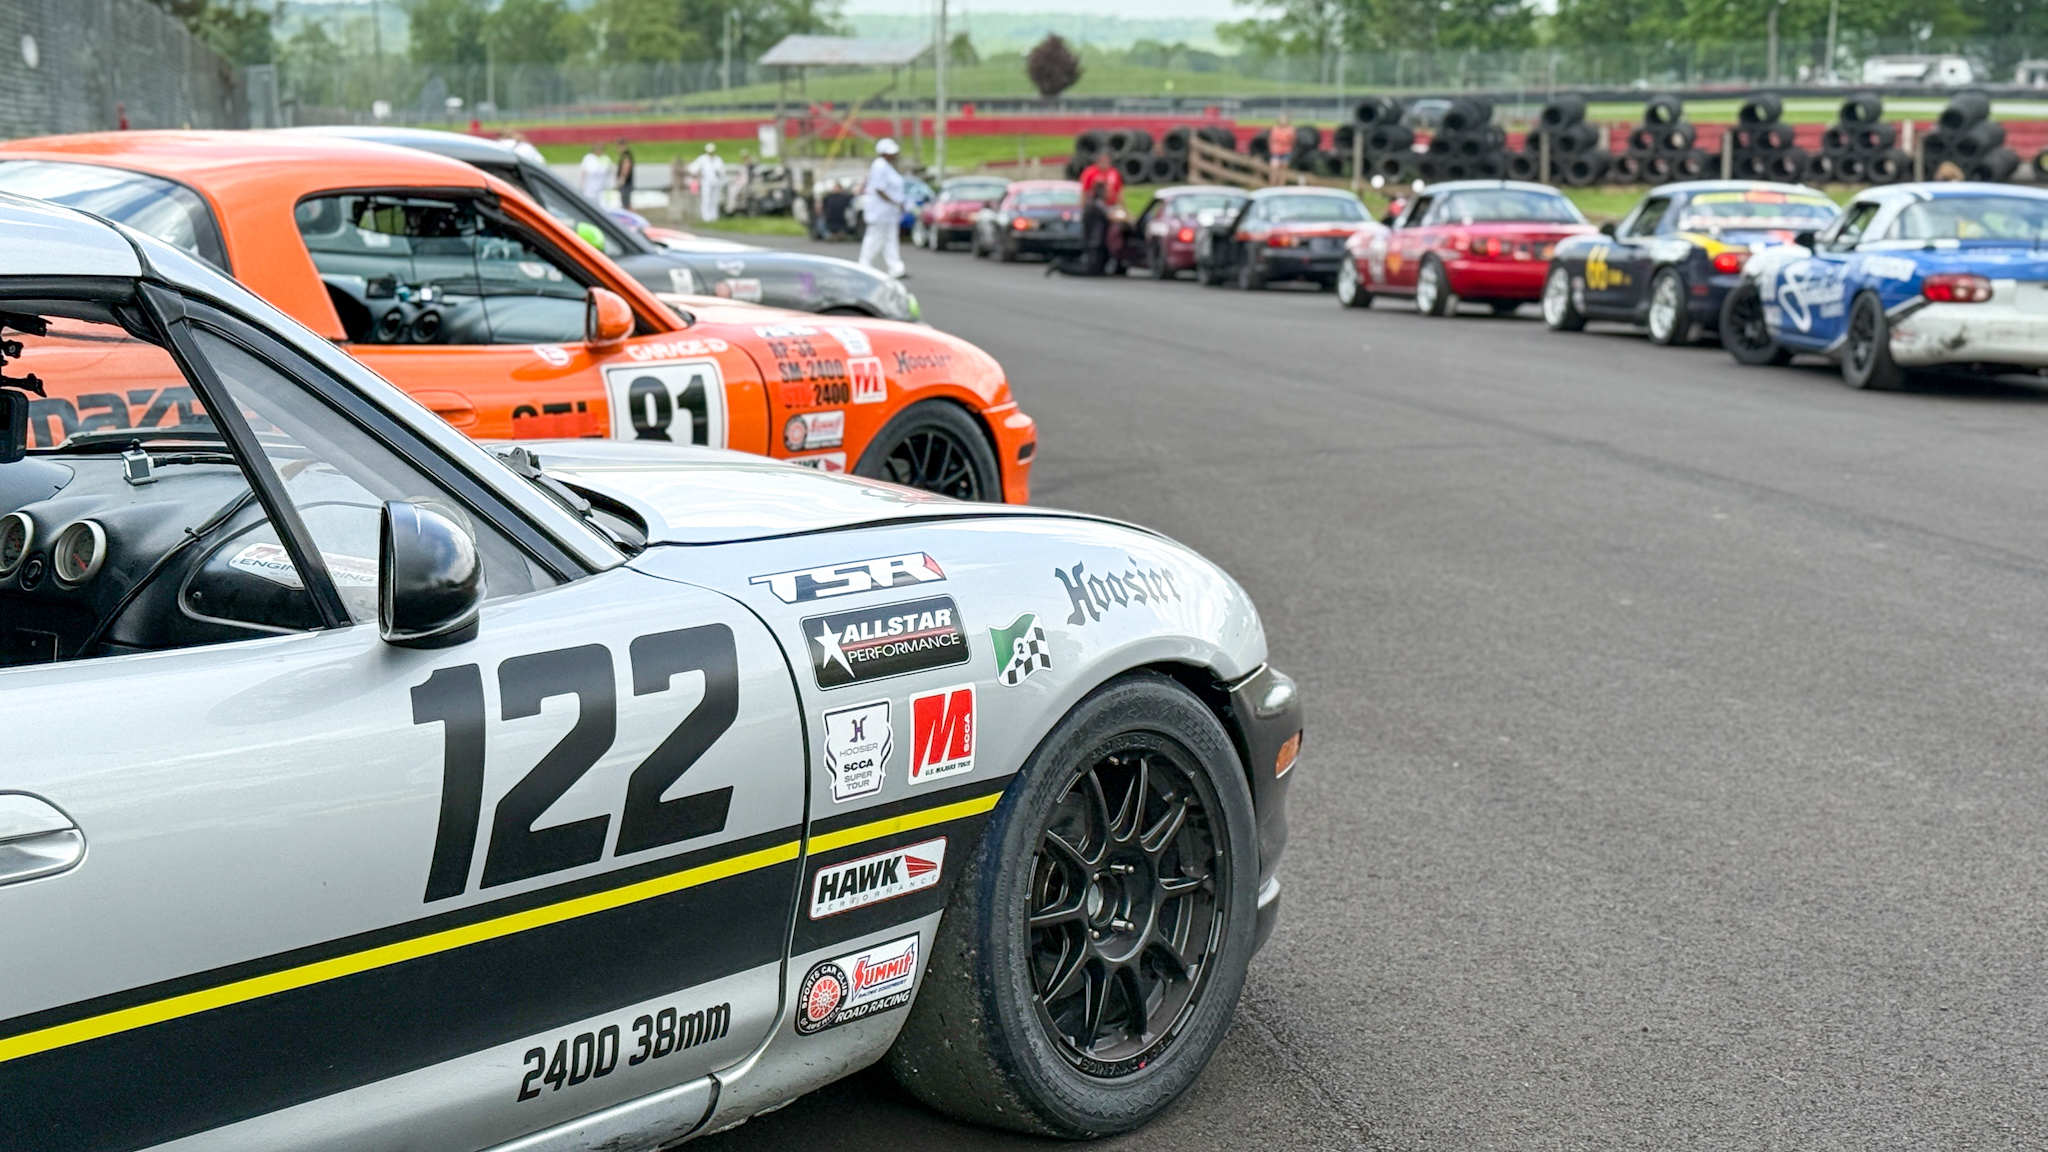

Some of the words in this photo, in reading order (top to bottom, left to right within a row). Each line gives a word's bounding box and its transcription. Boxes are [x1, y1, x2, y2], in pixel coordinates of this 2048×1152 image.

[813, 382, 851, 406] 2400
[749, 554, 946, 603] TSR
[1055, 555, 1181, 626] Hoosier
[842, 608, 952, 644] ALLSTAR
[847, 632, 960, 664] PERFORMANCE
[1016, 642, 1025, 655] 2
[839, 742, 879, 758] HOOSIER
[963, 713, 971, 753] SCCA
[410, 623, 739, 904] 122
[843, 758, 874, 773] SCCA
[844, 770, 873, 783] SUPER
[847, 780, 870, 790] TOUR
[815, 874, 937, 914] PERFORMANCE
[817, 855, 903, 905] HAWK
[801, 970, 820, 1009] SPORTS
[821, 966, 836, 975] CAR
[836, 970, 848, 997] CLUB
[835, 1004, 868, 1023] ROAD
[869, 989, 911, 1014] RACING
[517, 1024, 620, 1102] 2400
[629, 1002, 731, 1067] 38mm
